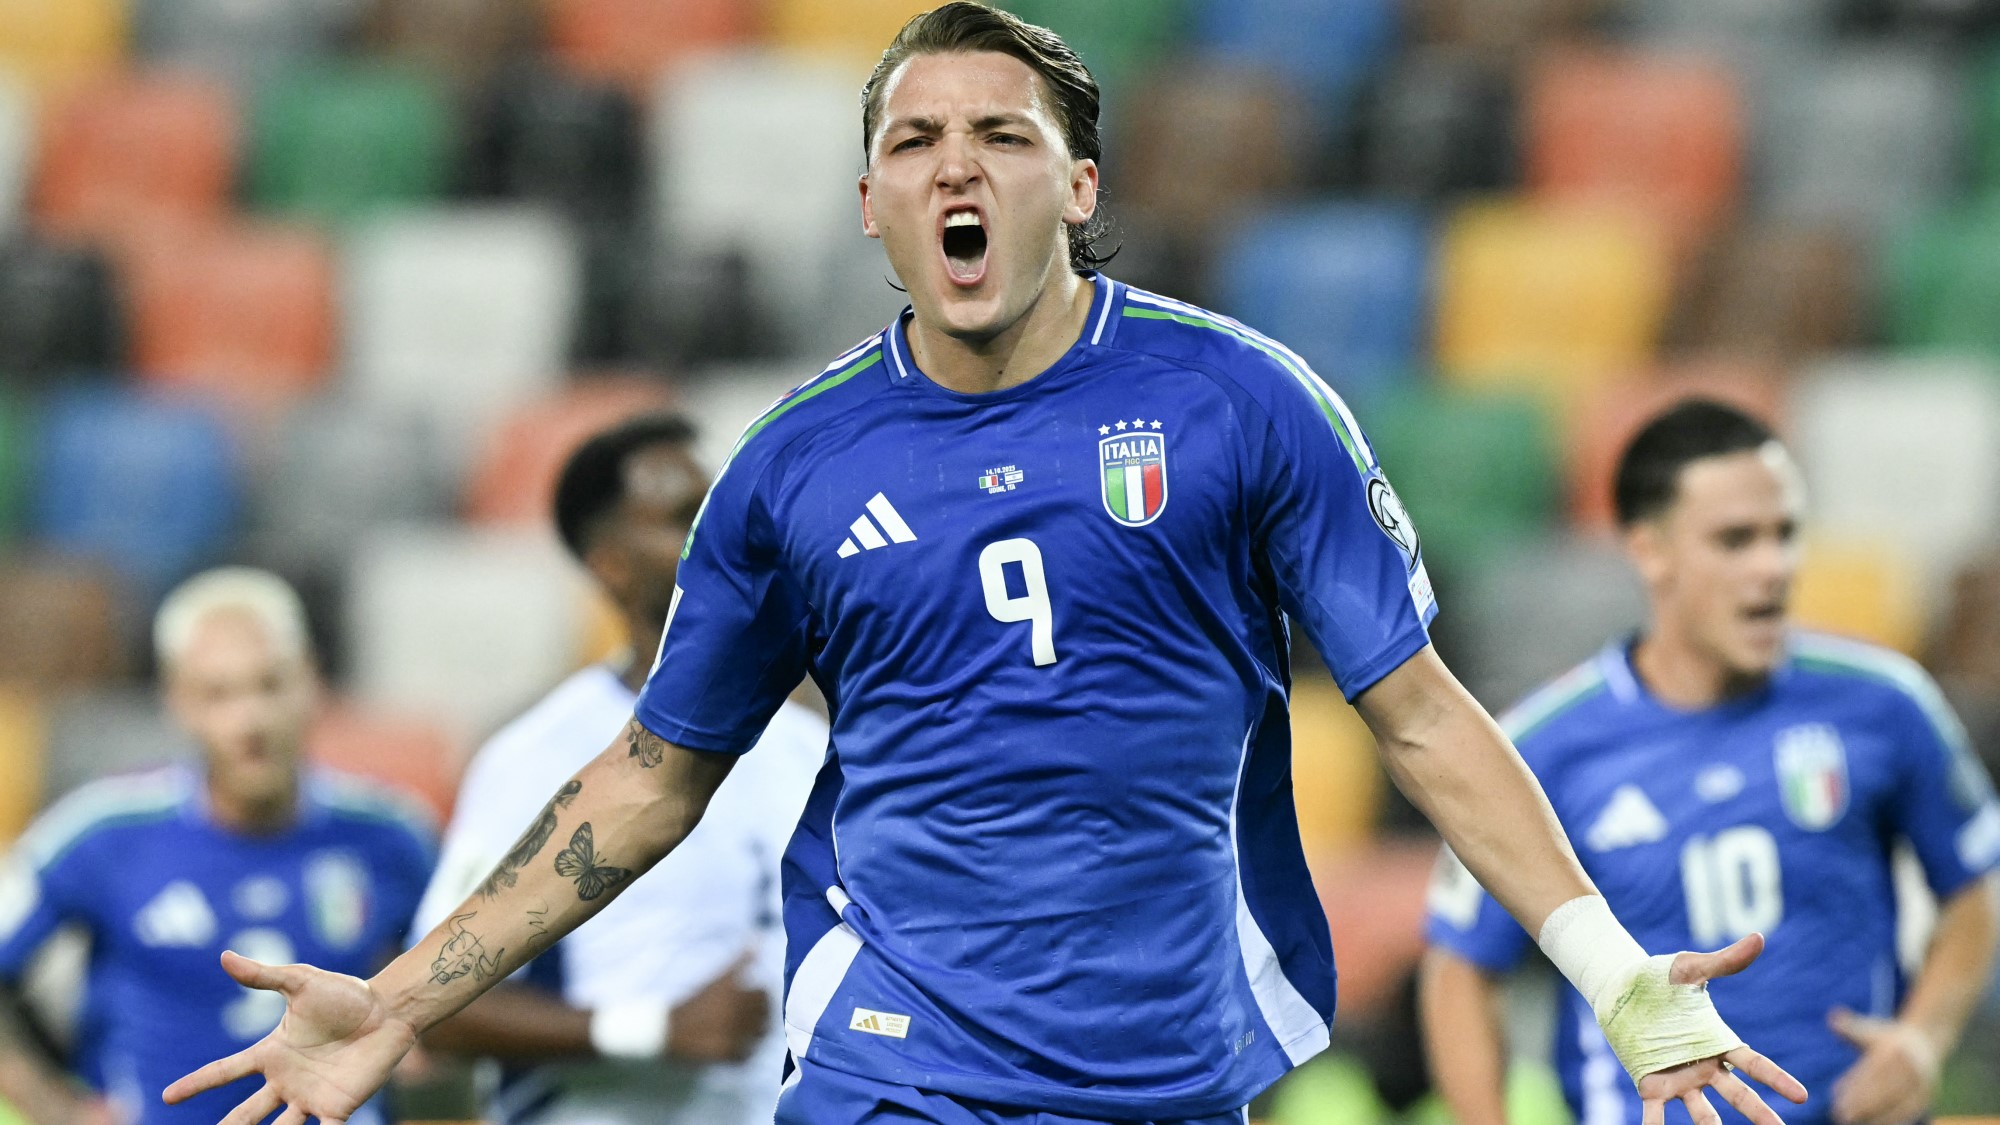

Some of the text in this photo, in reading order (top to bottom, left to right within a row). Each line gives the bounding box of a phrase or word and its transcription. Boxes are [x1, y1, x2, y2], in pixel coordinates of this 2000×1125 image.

[1104, 439, 1159, 460] ITALIA
[1124, 457, 1140, 466] FIGC
[979, 537, 1057, 666] 9
[1681, 826, 1783, 949] 10
